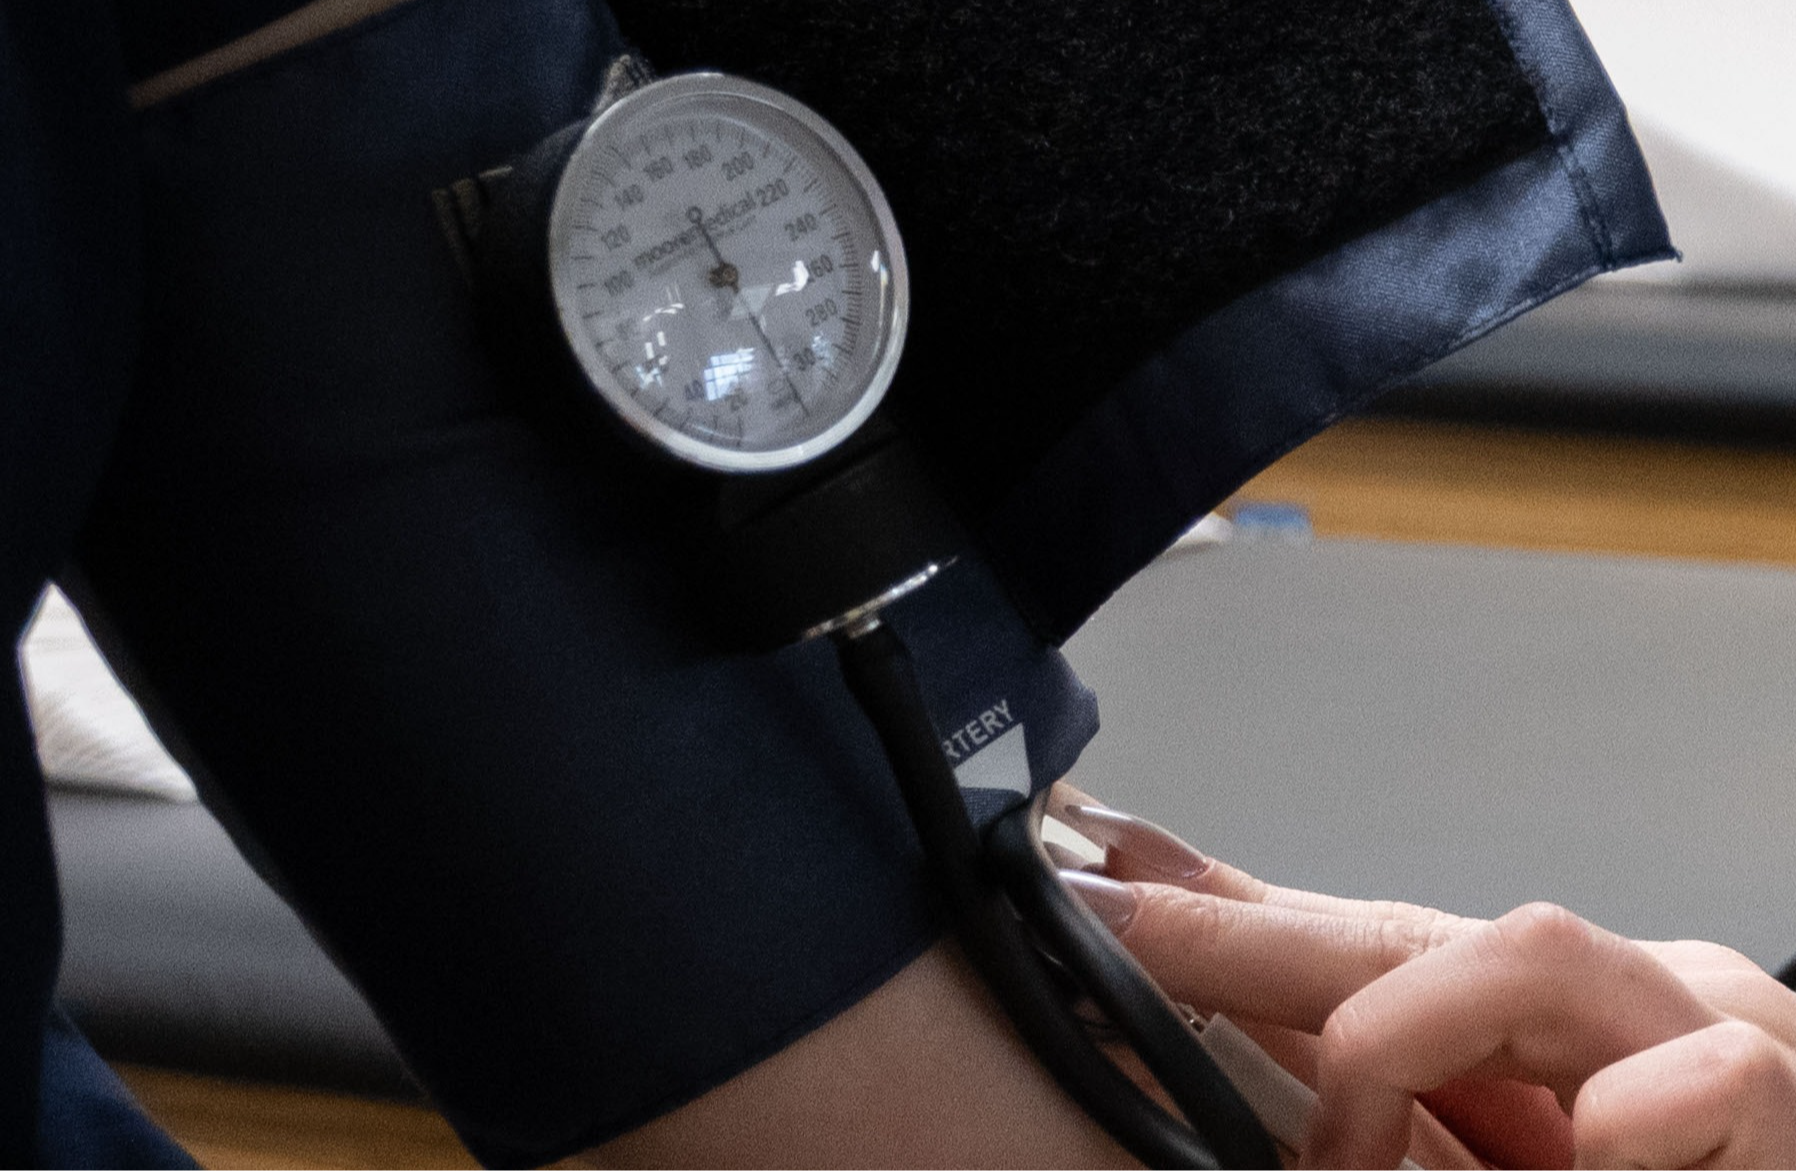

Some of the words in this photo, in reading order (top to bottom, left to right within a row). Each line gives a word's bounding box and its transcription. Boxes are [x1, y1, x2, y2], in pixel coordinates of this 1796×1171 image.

[721, 150, 756, 182] 200
[757, 178, 791, 208] 220
[602, 225, 631, 251] 120
[784, 213, 819, 242] 240
[805, 297, 838, 327] 280
[942, 699, 1014, 759] RTERY
